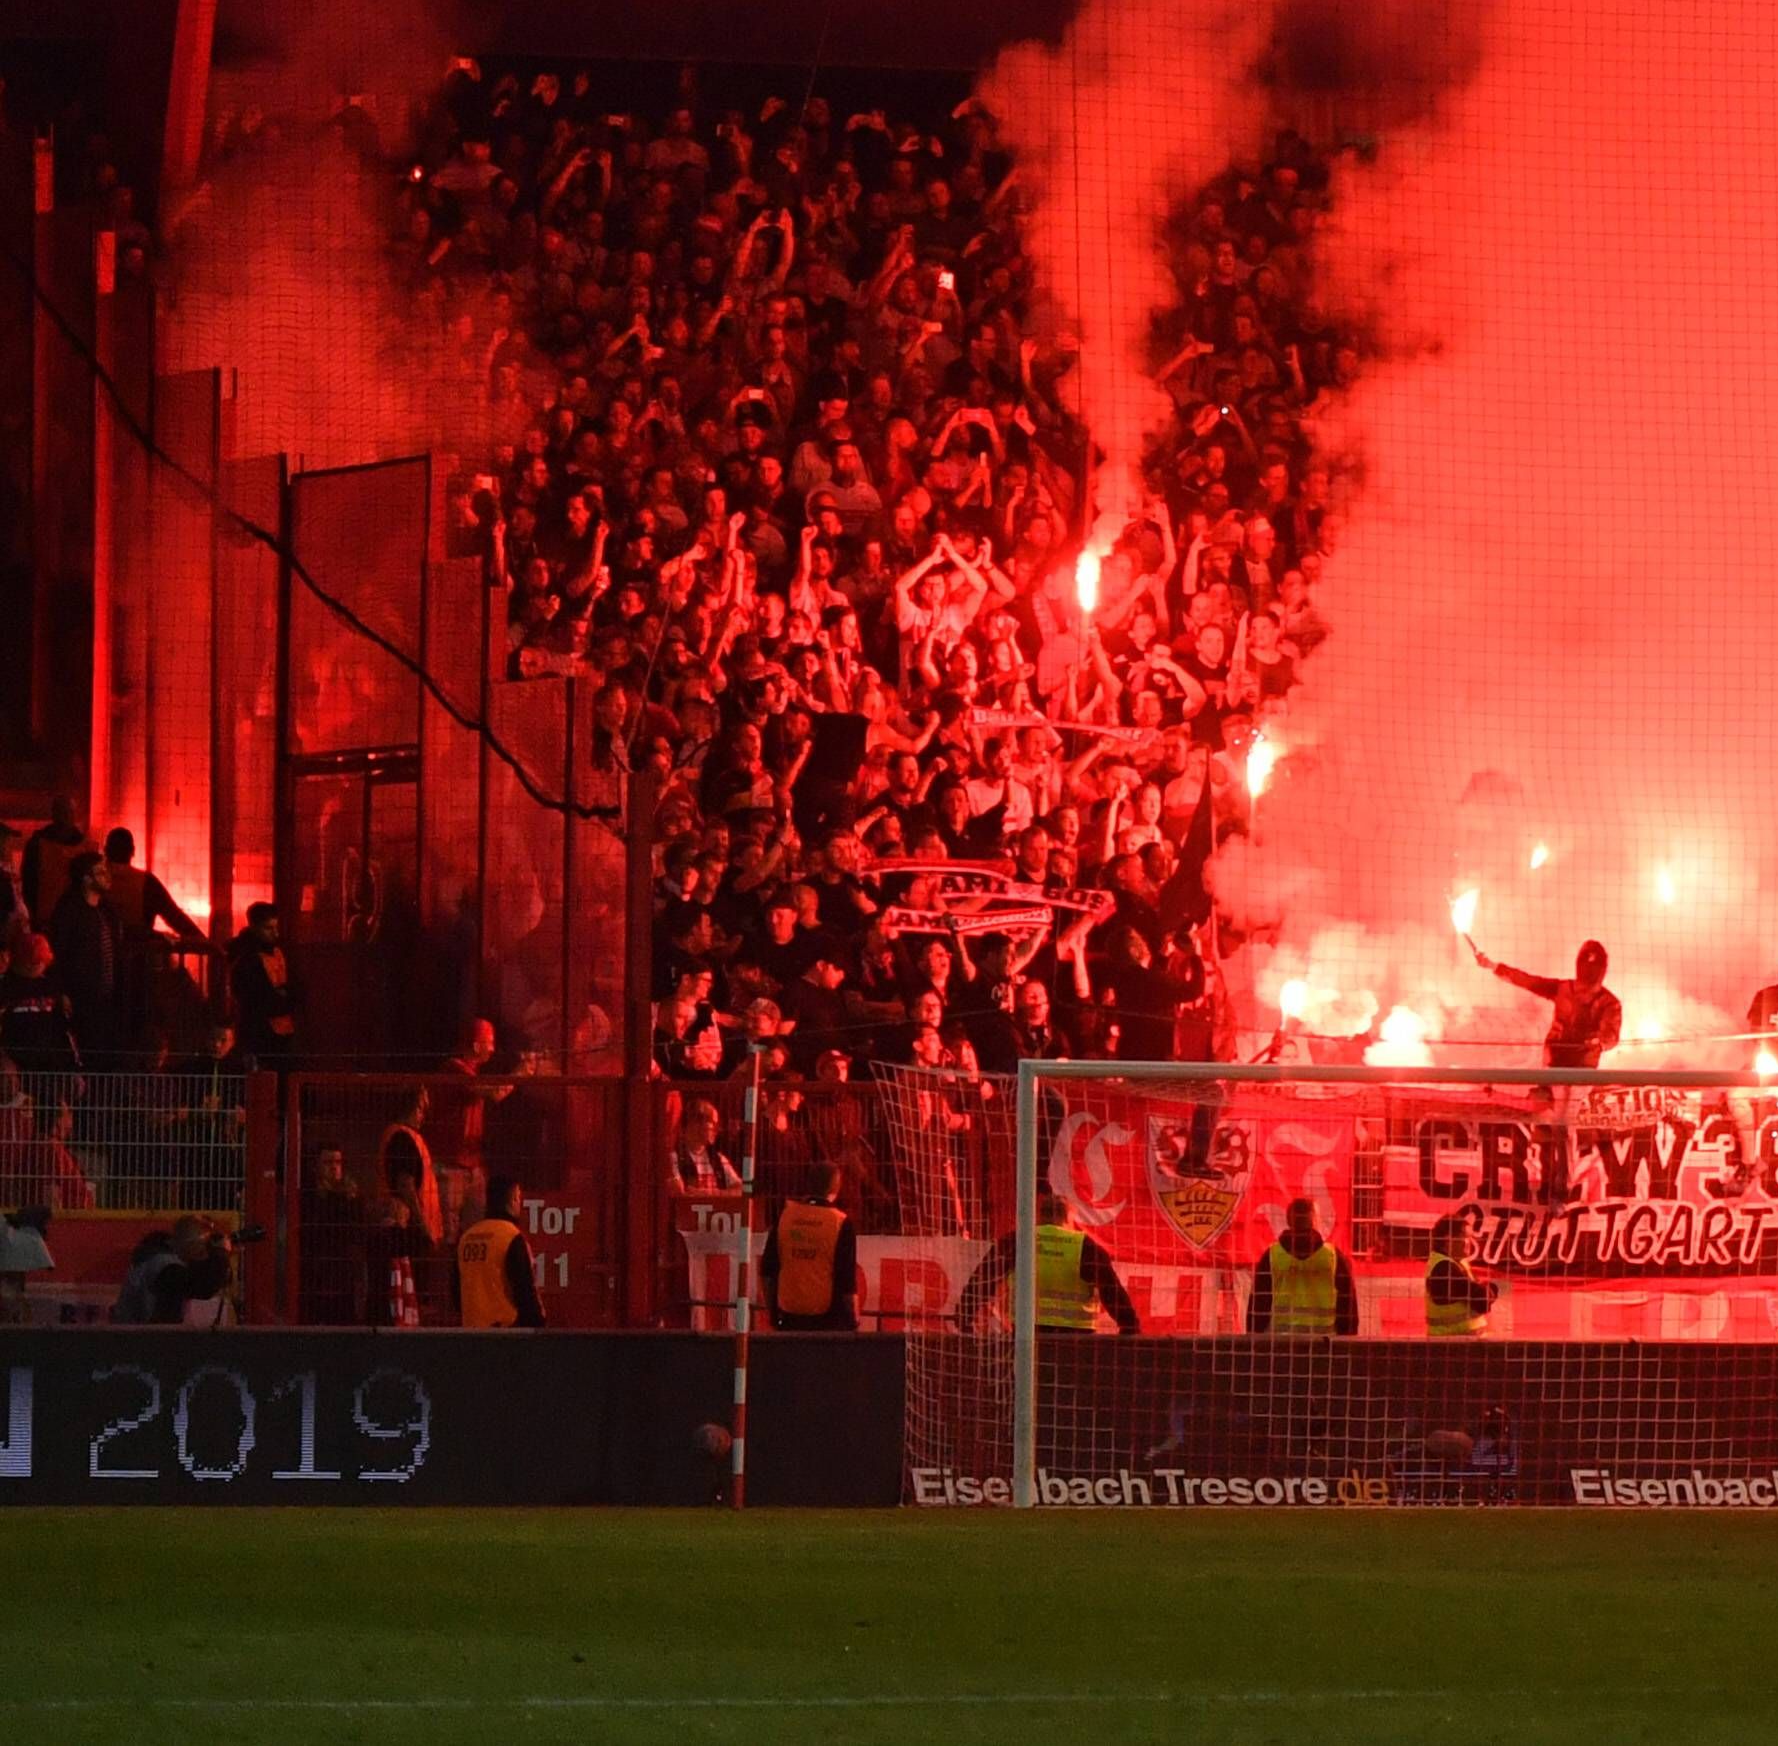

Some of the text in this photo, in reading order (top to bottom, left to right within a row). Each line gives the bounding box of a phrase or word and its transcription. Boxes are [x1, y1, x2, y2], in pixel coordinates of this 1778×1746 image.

[522, 1198, 580, 1235] Tor
[1455, 1198, 1775, 1266] STUTTGART
[533, 1252, 569, 1288] 11
[90, 1366, 431, 1482] 2019
[911, 1467, 1151, 1506] Eisebach
